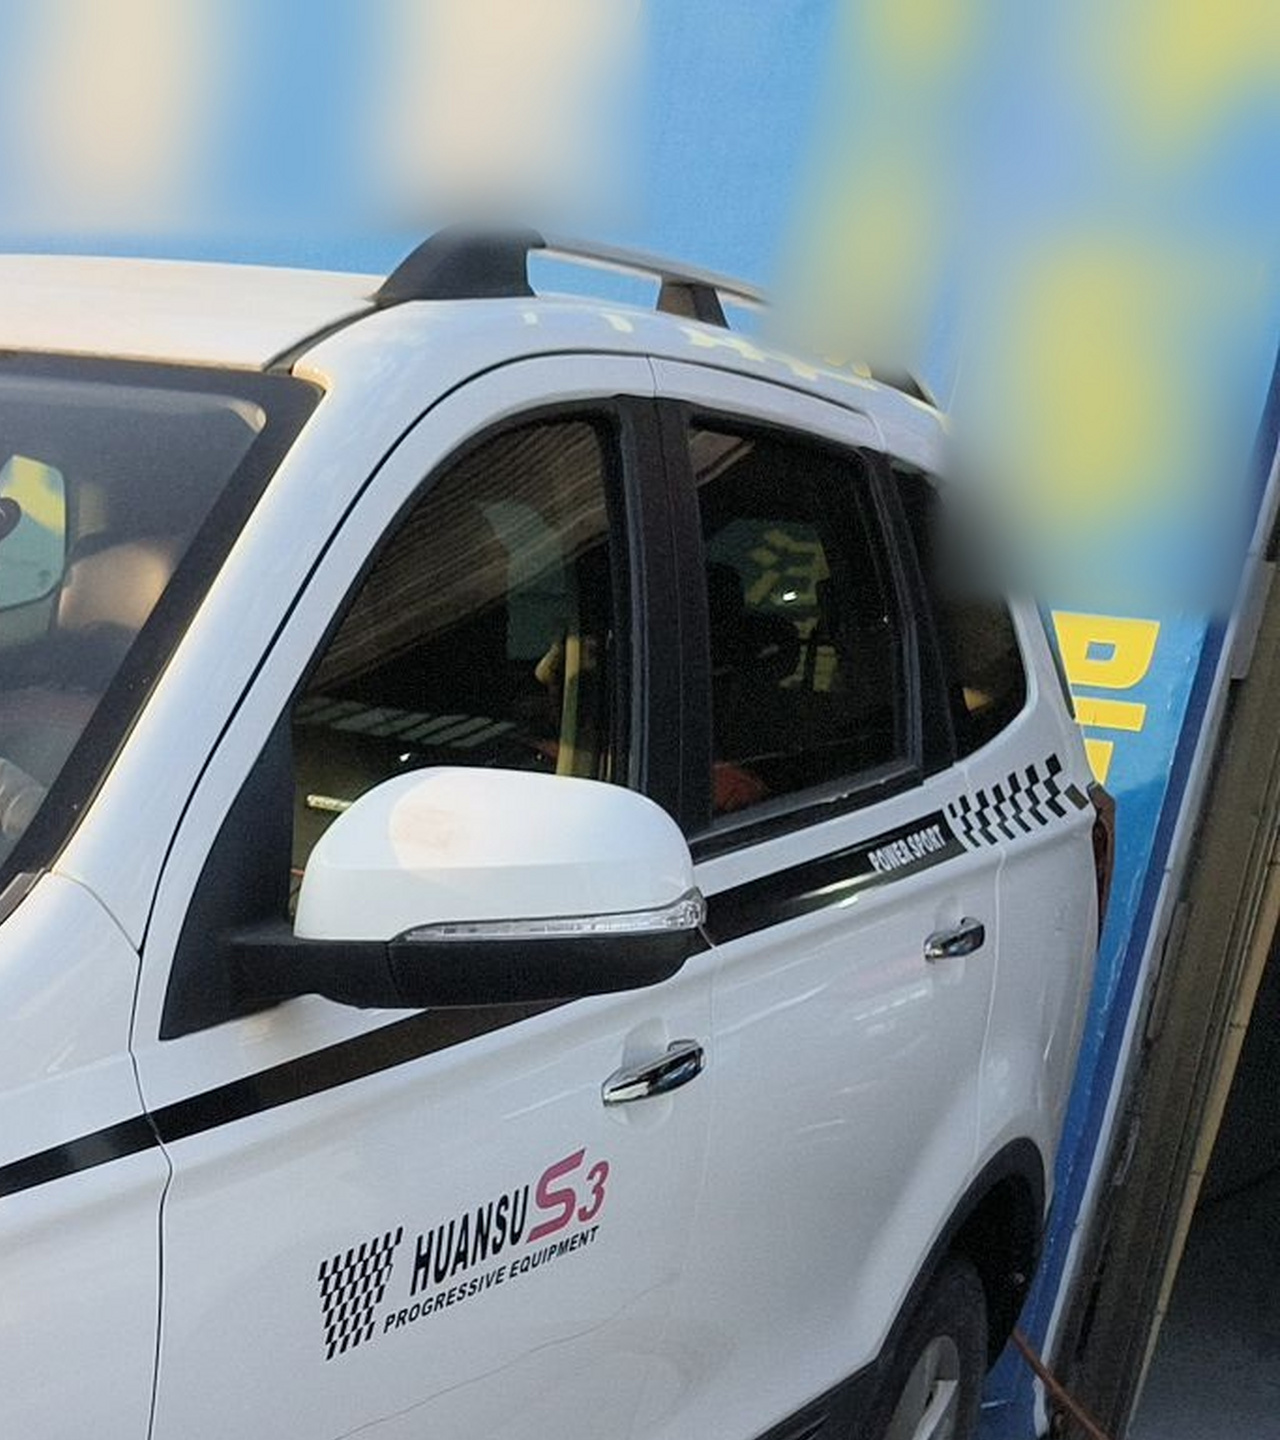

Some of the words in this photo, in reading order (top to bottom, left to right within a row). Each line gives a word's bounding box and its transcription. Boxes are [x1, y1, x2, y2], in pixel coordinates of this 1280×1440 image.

[867, 838, 915, 872] POWER
[906, 824, 946, 858] SPORT
[409, 1184, 529, 1296] HUANSU
[526, 1147, 609, 1243] S3
[383, 1266, 506, 1334] PROGRESSIVE
[509, 1225, 600, 1278] EQUIPMENT
